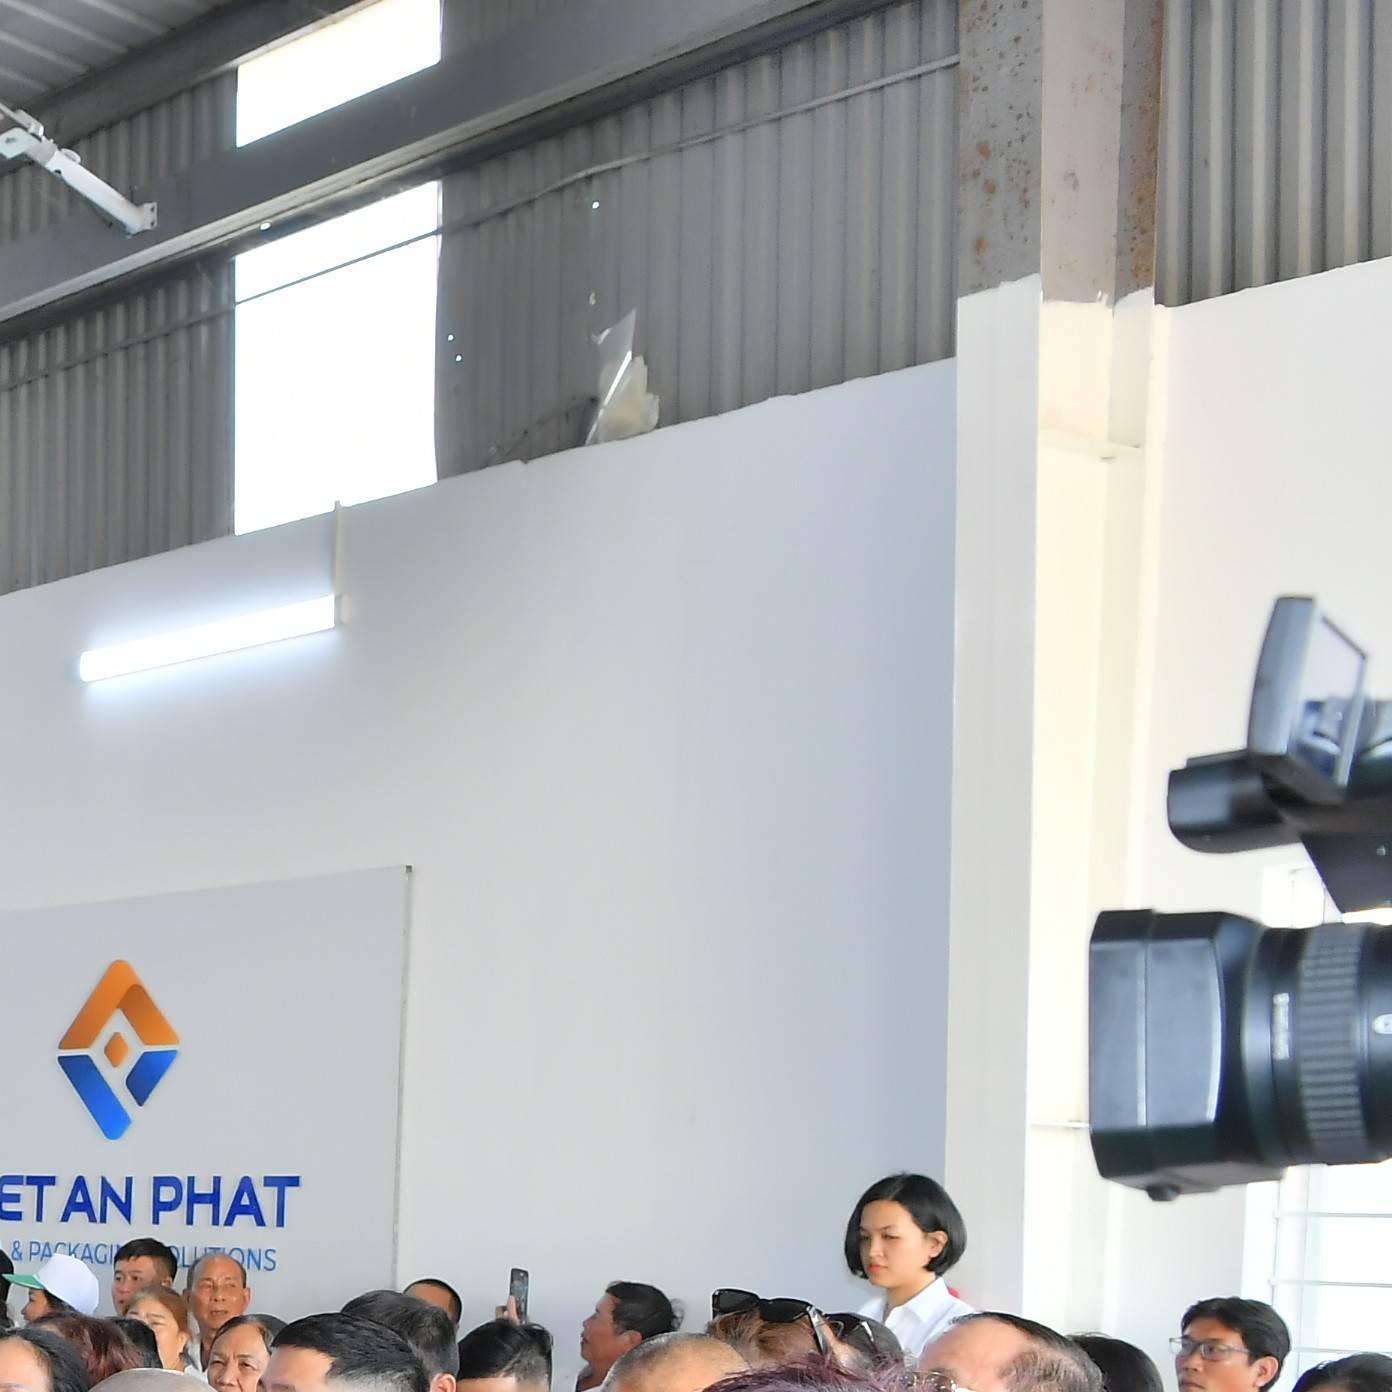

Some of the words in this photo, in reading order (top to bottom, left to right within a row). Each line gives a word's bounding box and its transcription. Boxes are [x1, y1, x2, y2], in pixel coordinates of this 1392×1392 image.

[60, 1175, 133, 1224] AN
[152, 1176, 301, 1228] PHAT
[11, 1240, 23, 1261] &
